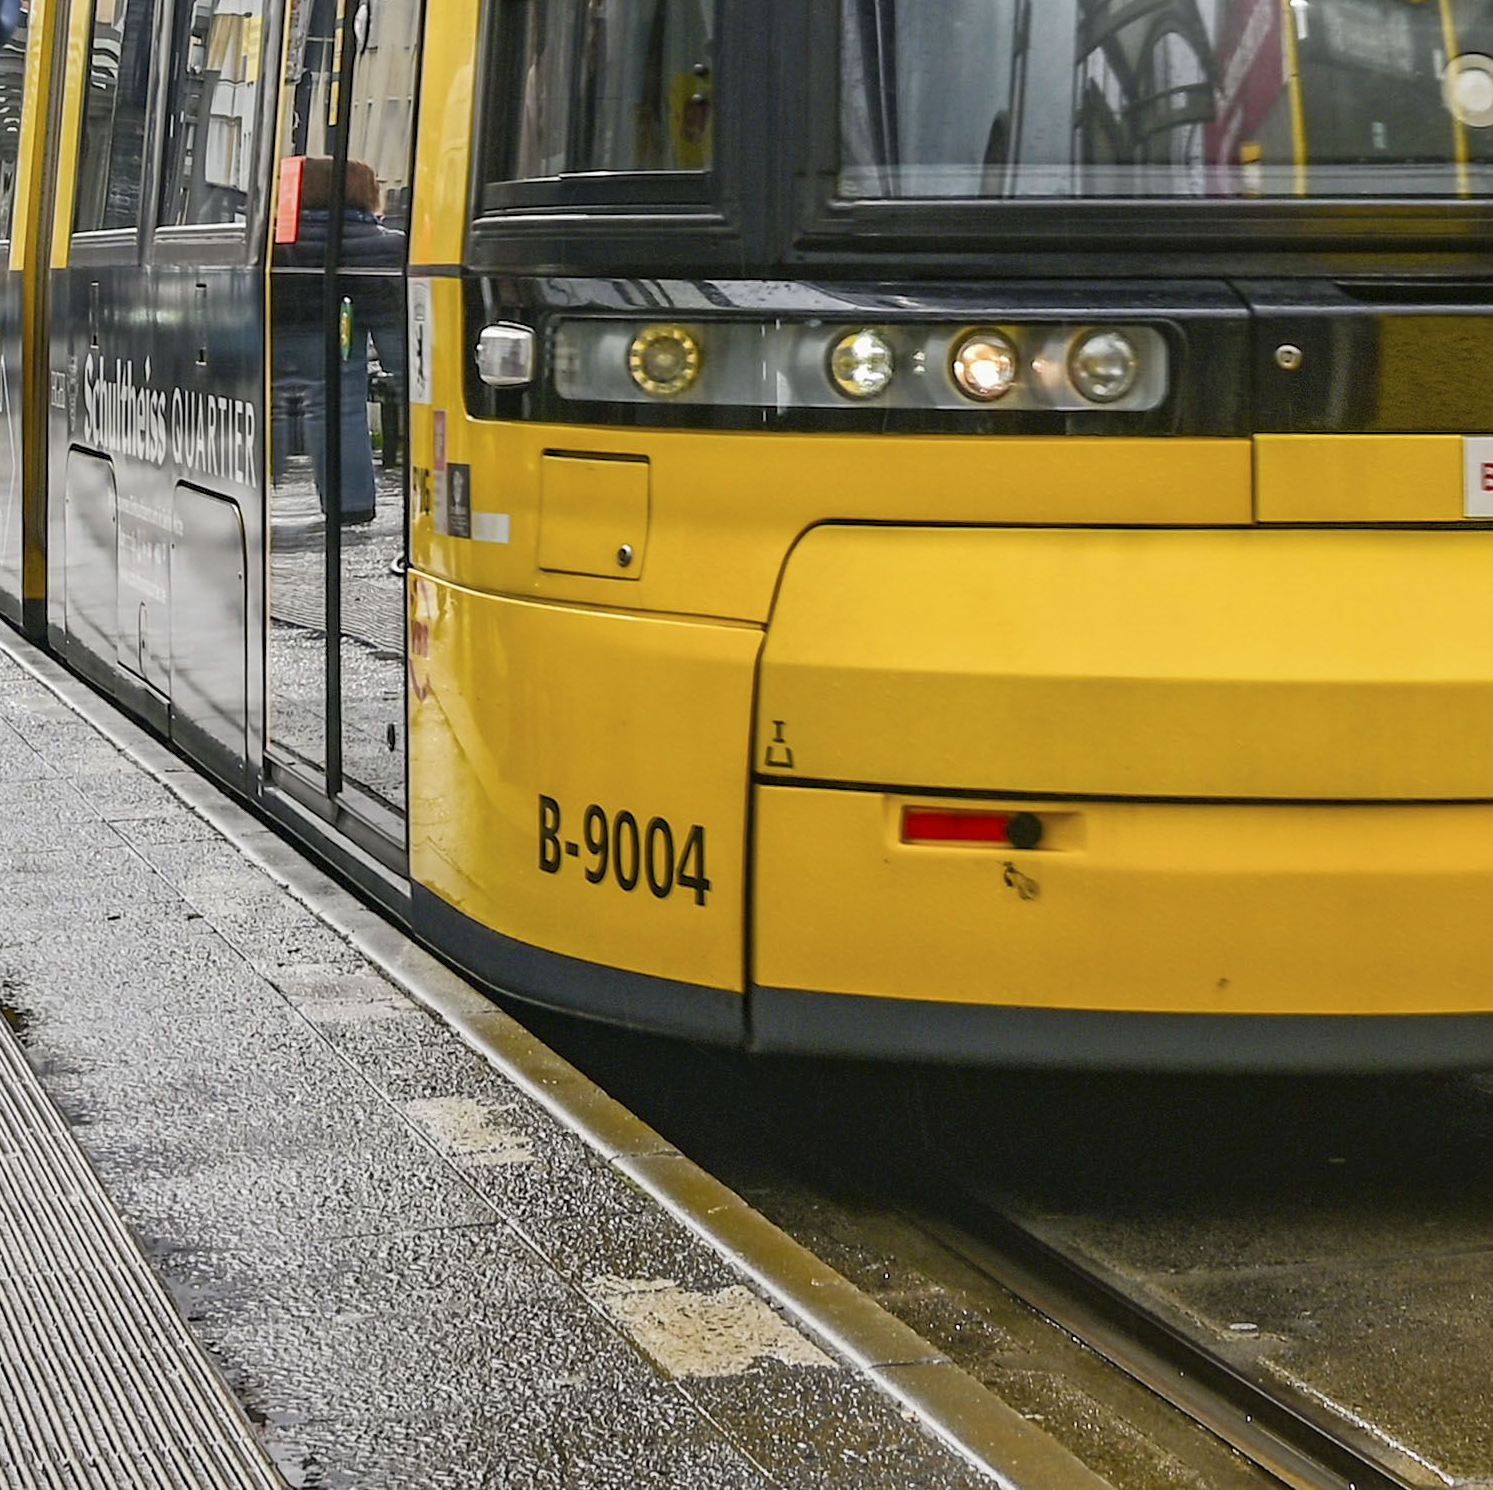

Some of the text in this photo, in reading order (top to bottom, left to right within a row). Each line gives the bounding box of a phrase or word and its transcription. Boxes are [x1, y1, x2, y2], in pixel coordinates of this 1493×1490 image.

[83, 353, 166, 466] Schultheiss
[171, 387, 257, 489] QUARTIER
[538, 793, 712, 907] B-9004
